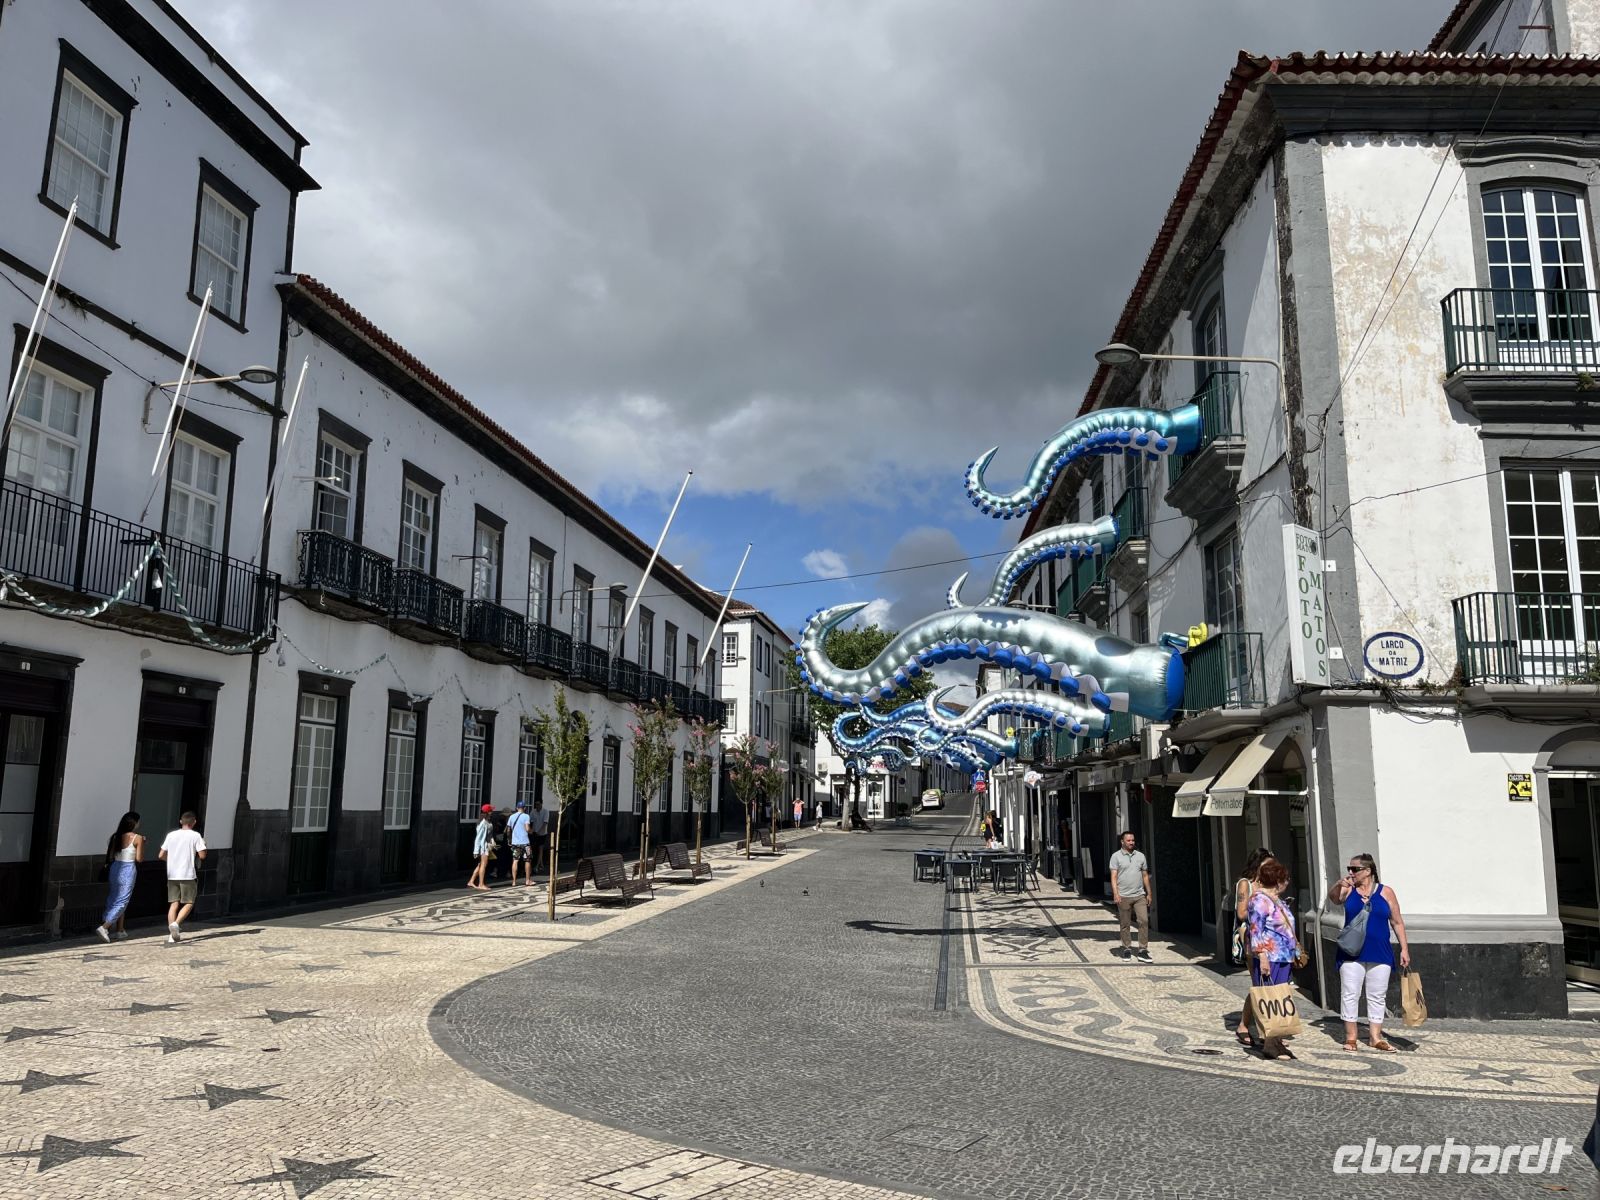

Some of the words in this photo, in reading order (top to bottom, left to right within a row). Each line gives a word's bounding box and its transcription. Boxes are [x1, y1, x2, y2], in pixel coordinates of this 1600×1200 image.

[1297, 554, 1313, 639] FOTO
[1309, 571, 1327, 677] MATOS
[1378, 657, 1408, 666] MATRIZ
[1210, 798, 1243, 810] Fotomatos
